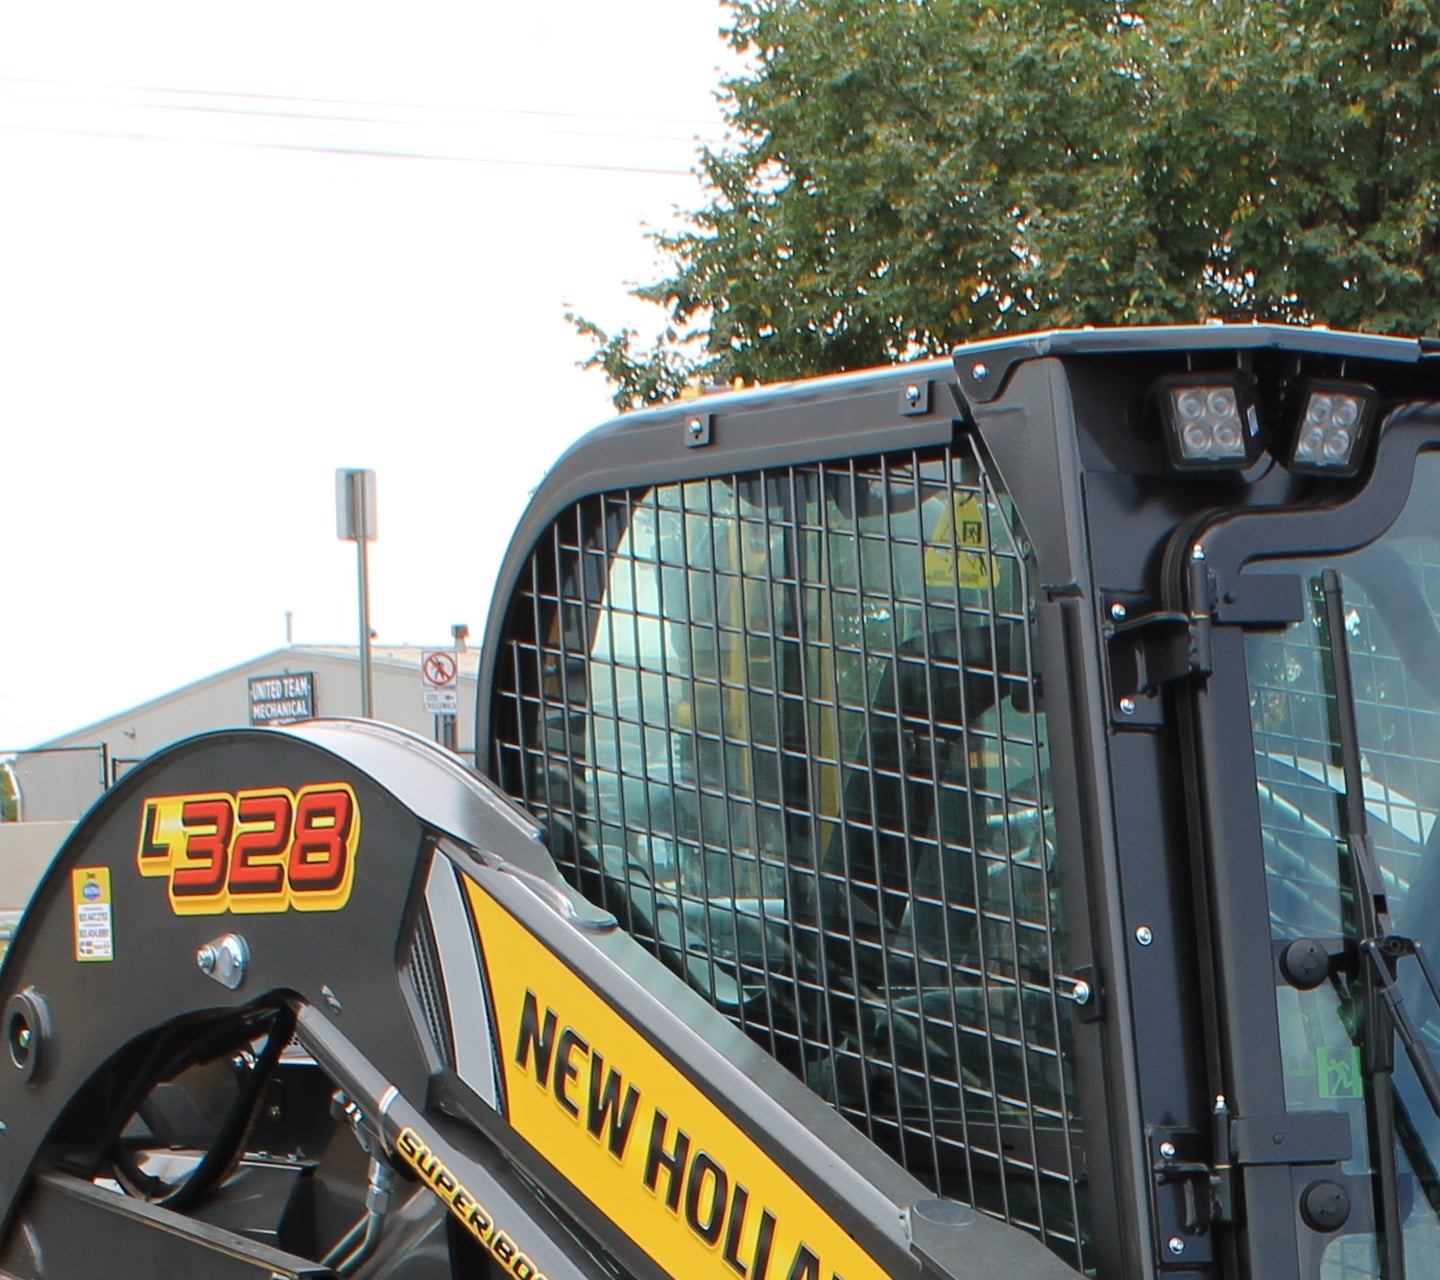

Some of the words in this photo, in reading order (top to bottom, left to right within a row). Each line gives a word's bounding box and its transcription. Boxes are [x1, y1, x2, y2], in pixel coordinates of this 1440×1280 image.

[251, 679, 282, 701] UNITED
[282, 675, 308, 699] TEAM
[252, 699, 309, 720] MECHANICAL
[139, 783, 359, 910] L328
[514, 986, 641, 1163] NEW
